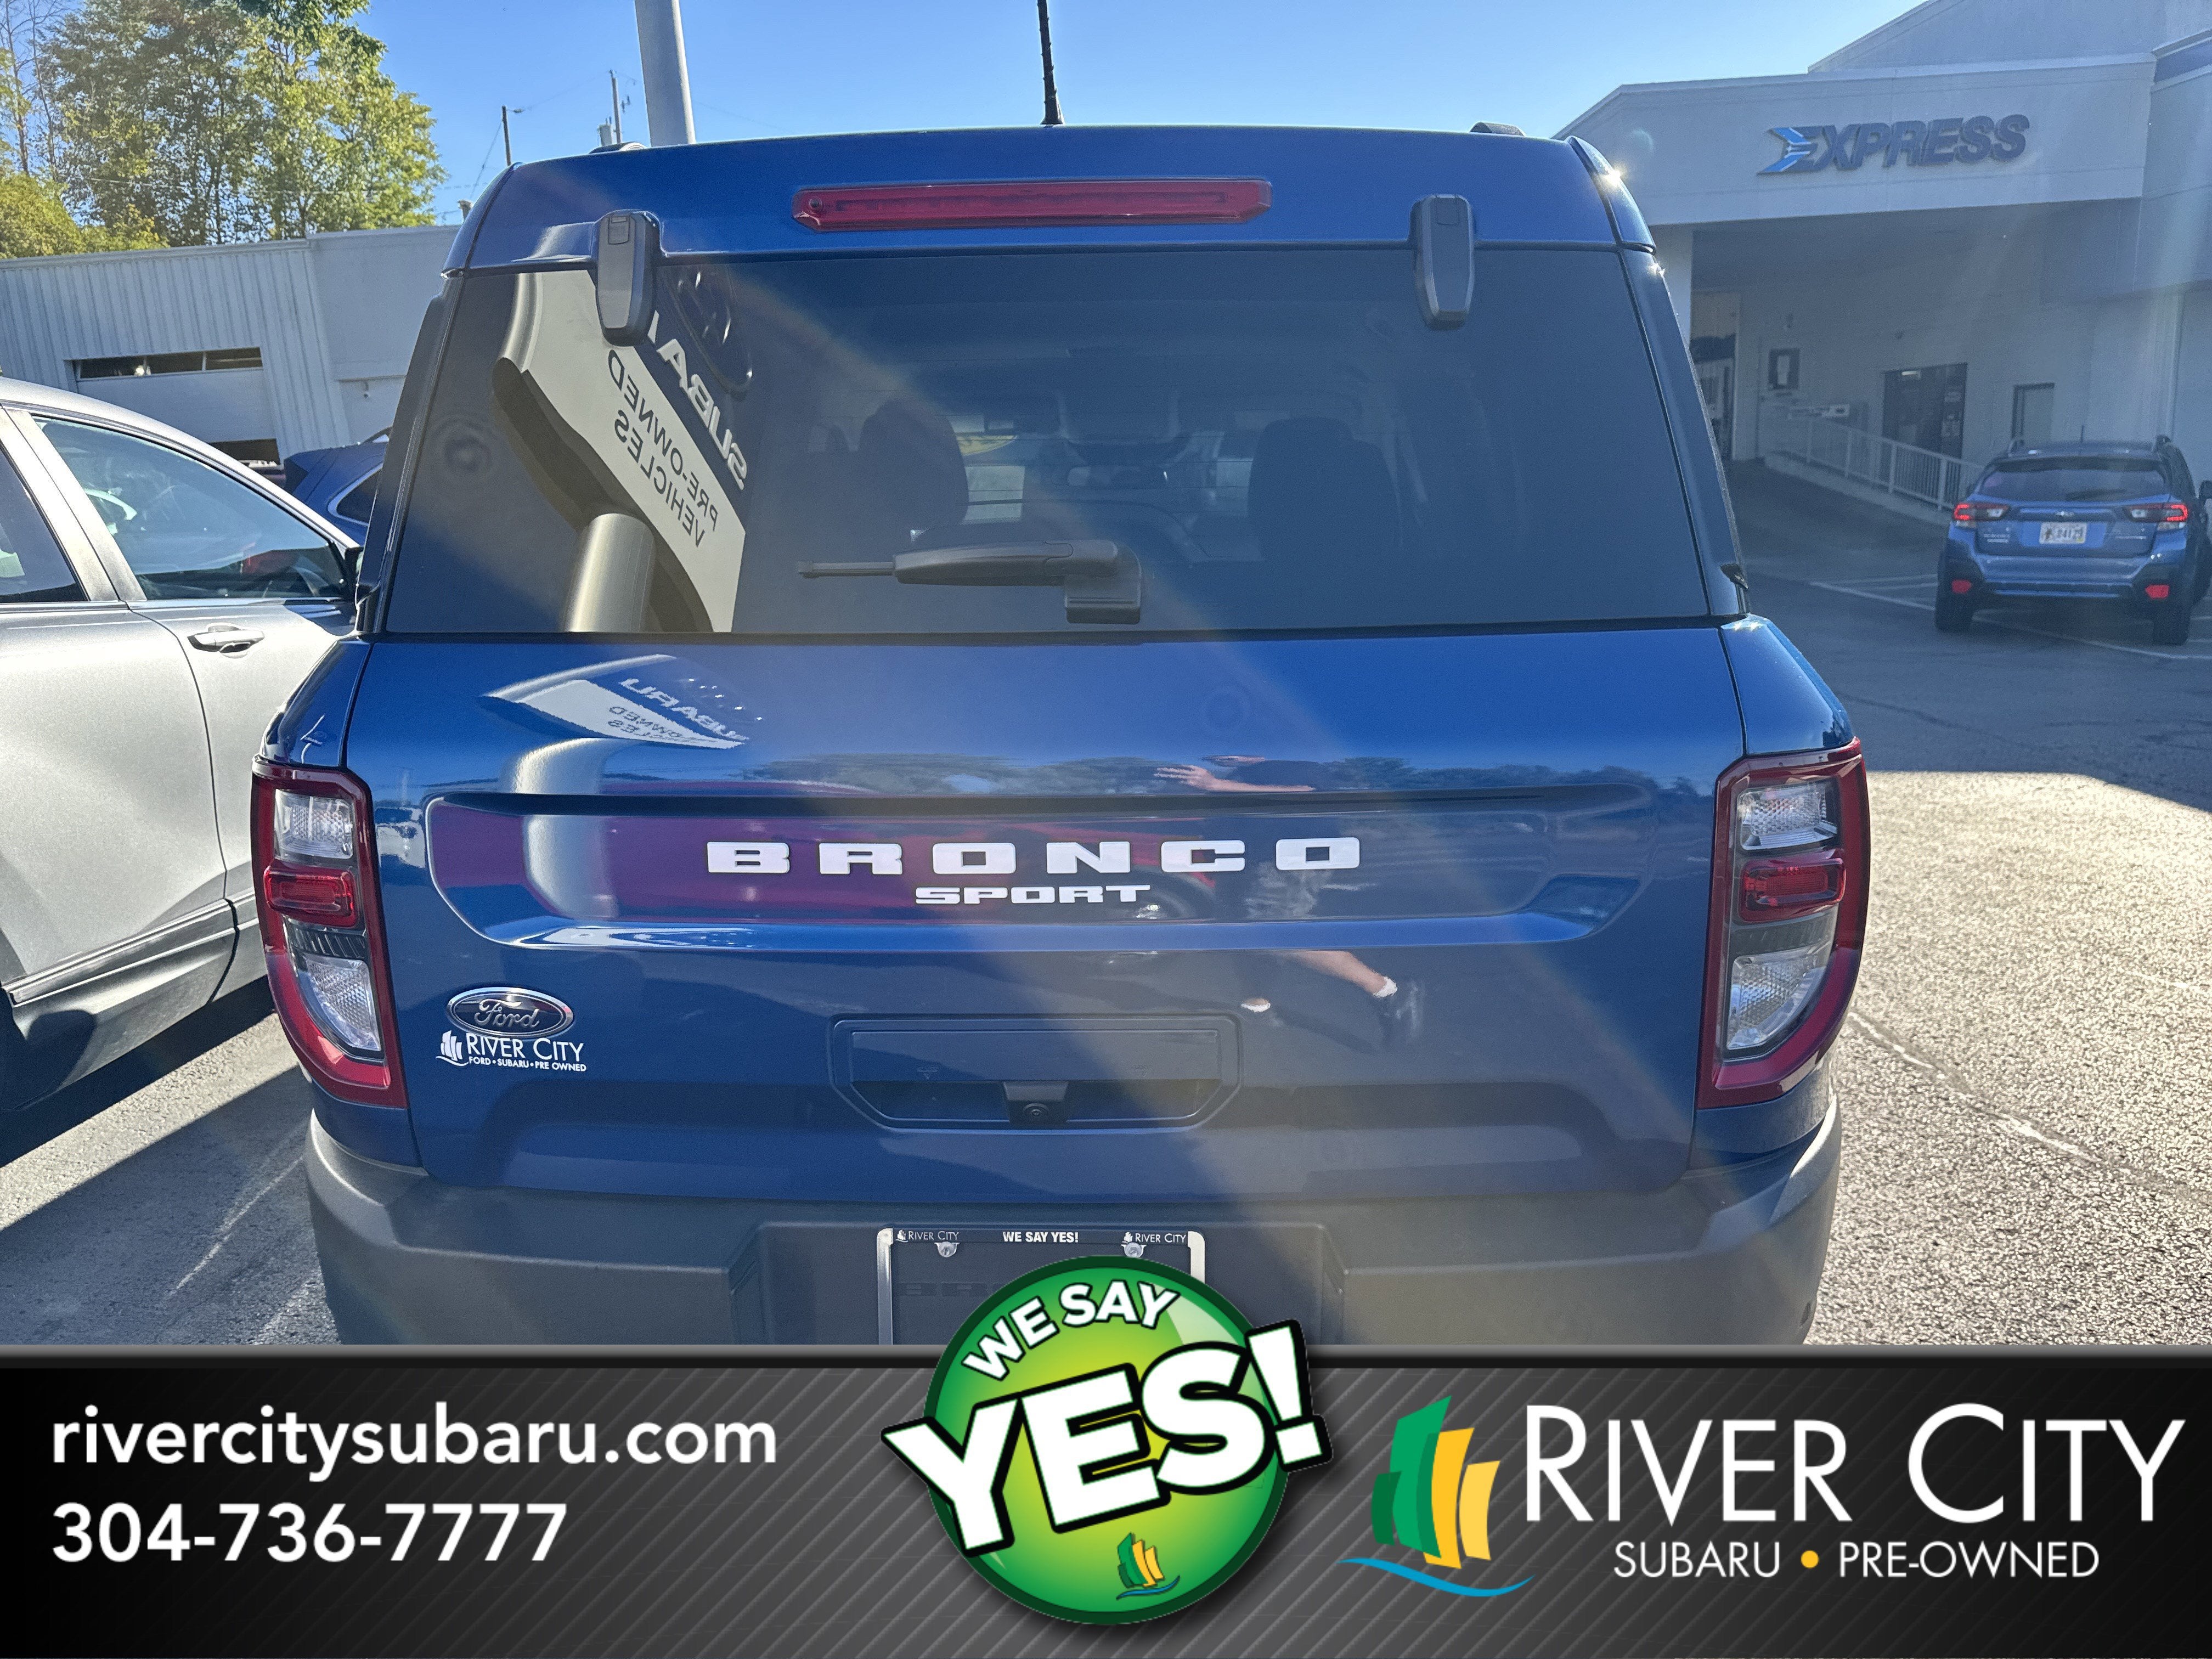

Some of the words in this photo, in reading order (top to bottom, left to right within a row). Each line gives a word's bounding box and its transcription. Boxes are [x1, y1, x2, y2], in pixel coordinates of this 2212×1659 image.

[1757, 114, 2030, 176] EXPRESS
[706, 837, 1360, 874] BRONCO
[915, 884, 1150, 905] SPORT
[475, 998, 540, 1028] Ford
[466, 1033, 526, 1059] RIVER
[533, 1038, 584, 1062] CITY
[469, 1056, 490, 1065] FORD
[497, 1059, 529, 1068] SUBARU
[535, 1061, 549, 1069] PRE
[551, 1062, 587, 1071] OWNED
[908, 1231, 934, 1241] RIVER
[938, 1231, 959, 1241] CITY
[1002, 1231, 1023, 1243] WE
[1025, 1231, 1048, 1243] SAY
[1051, 1231, 1079, 1243] YES!
[1135, 1233, 1161, 1243] RIVER
[1164, 1233, 1187, 1243] CITY
